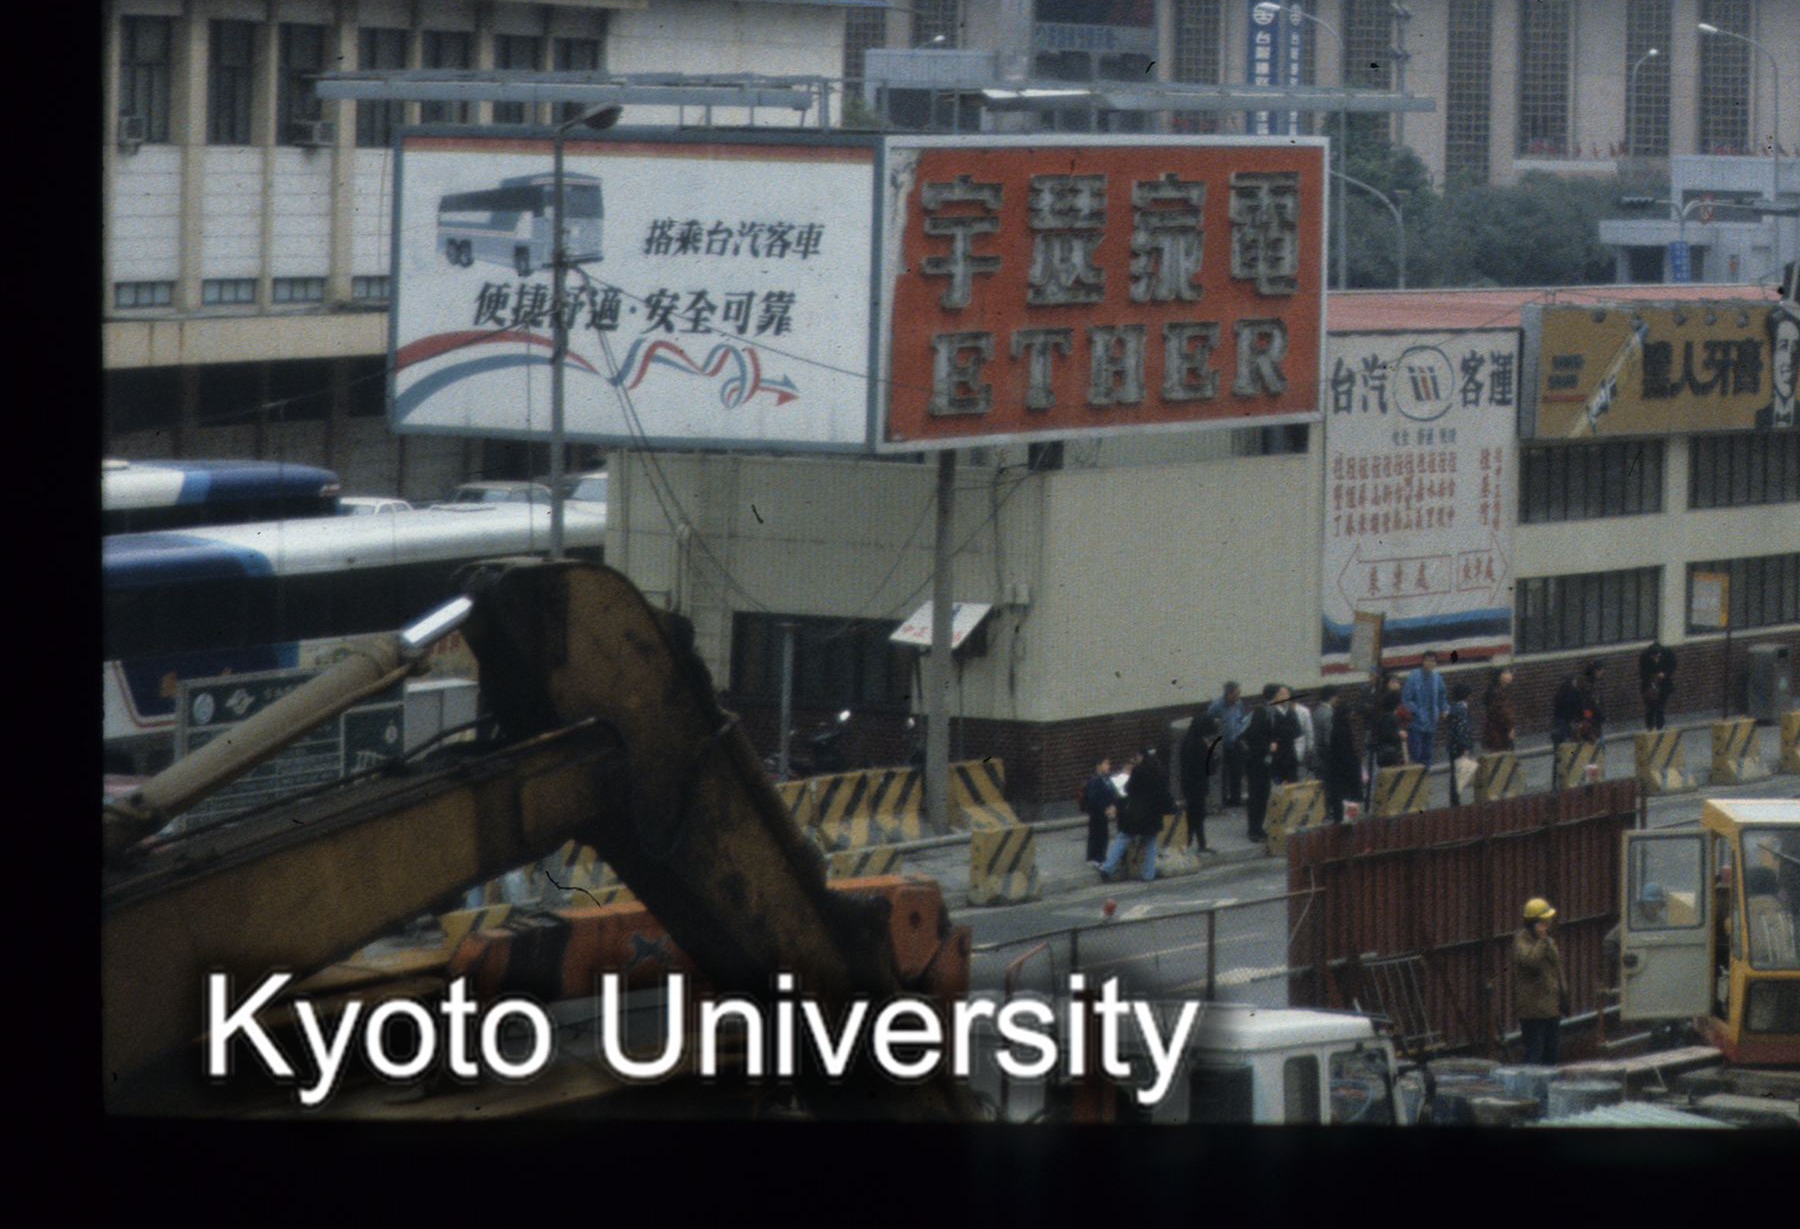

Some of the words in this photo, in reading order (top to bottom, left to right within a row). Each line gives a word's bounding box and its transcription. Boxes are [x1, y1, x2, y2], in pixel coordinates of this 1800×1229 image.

[644, 219, 825, 260] 搭乘台汽客車
[929, 318, 1289, 416] ETHER
[1330, 354, 1388, 414] 台汽
[1460, 350, 1514, 408] 客運
